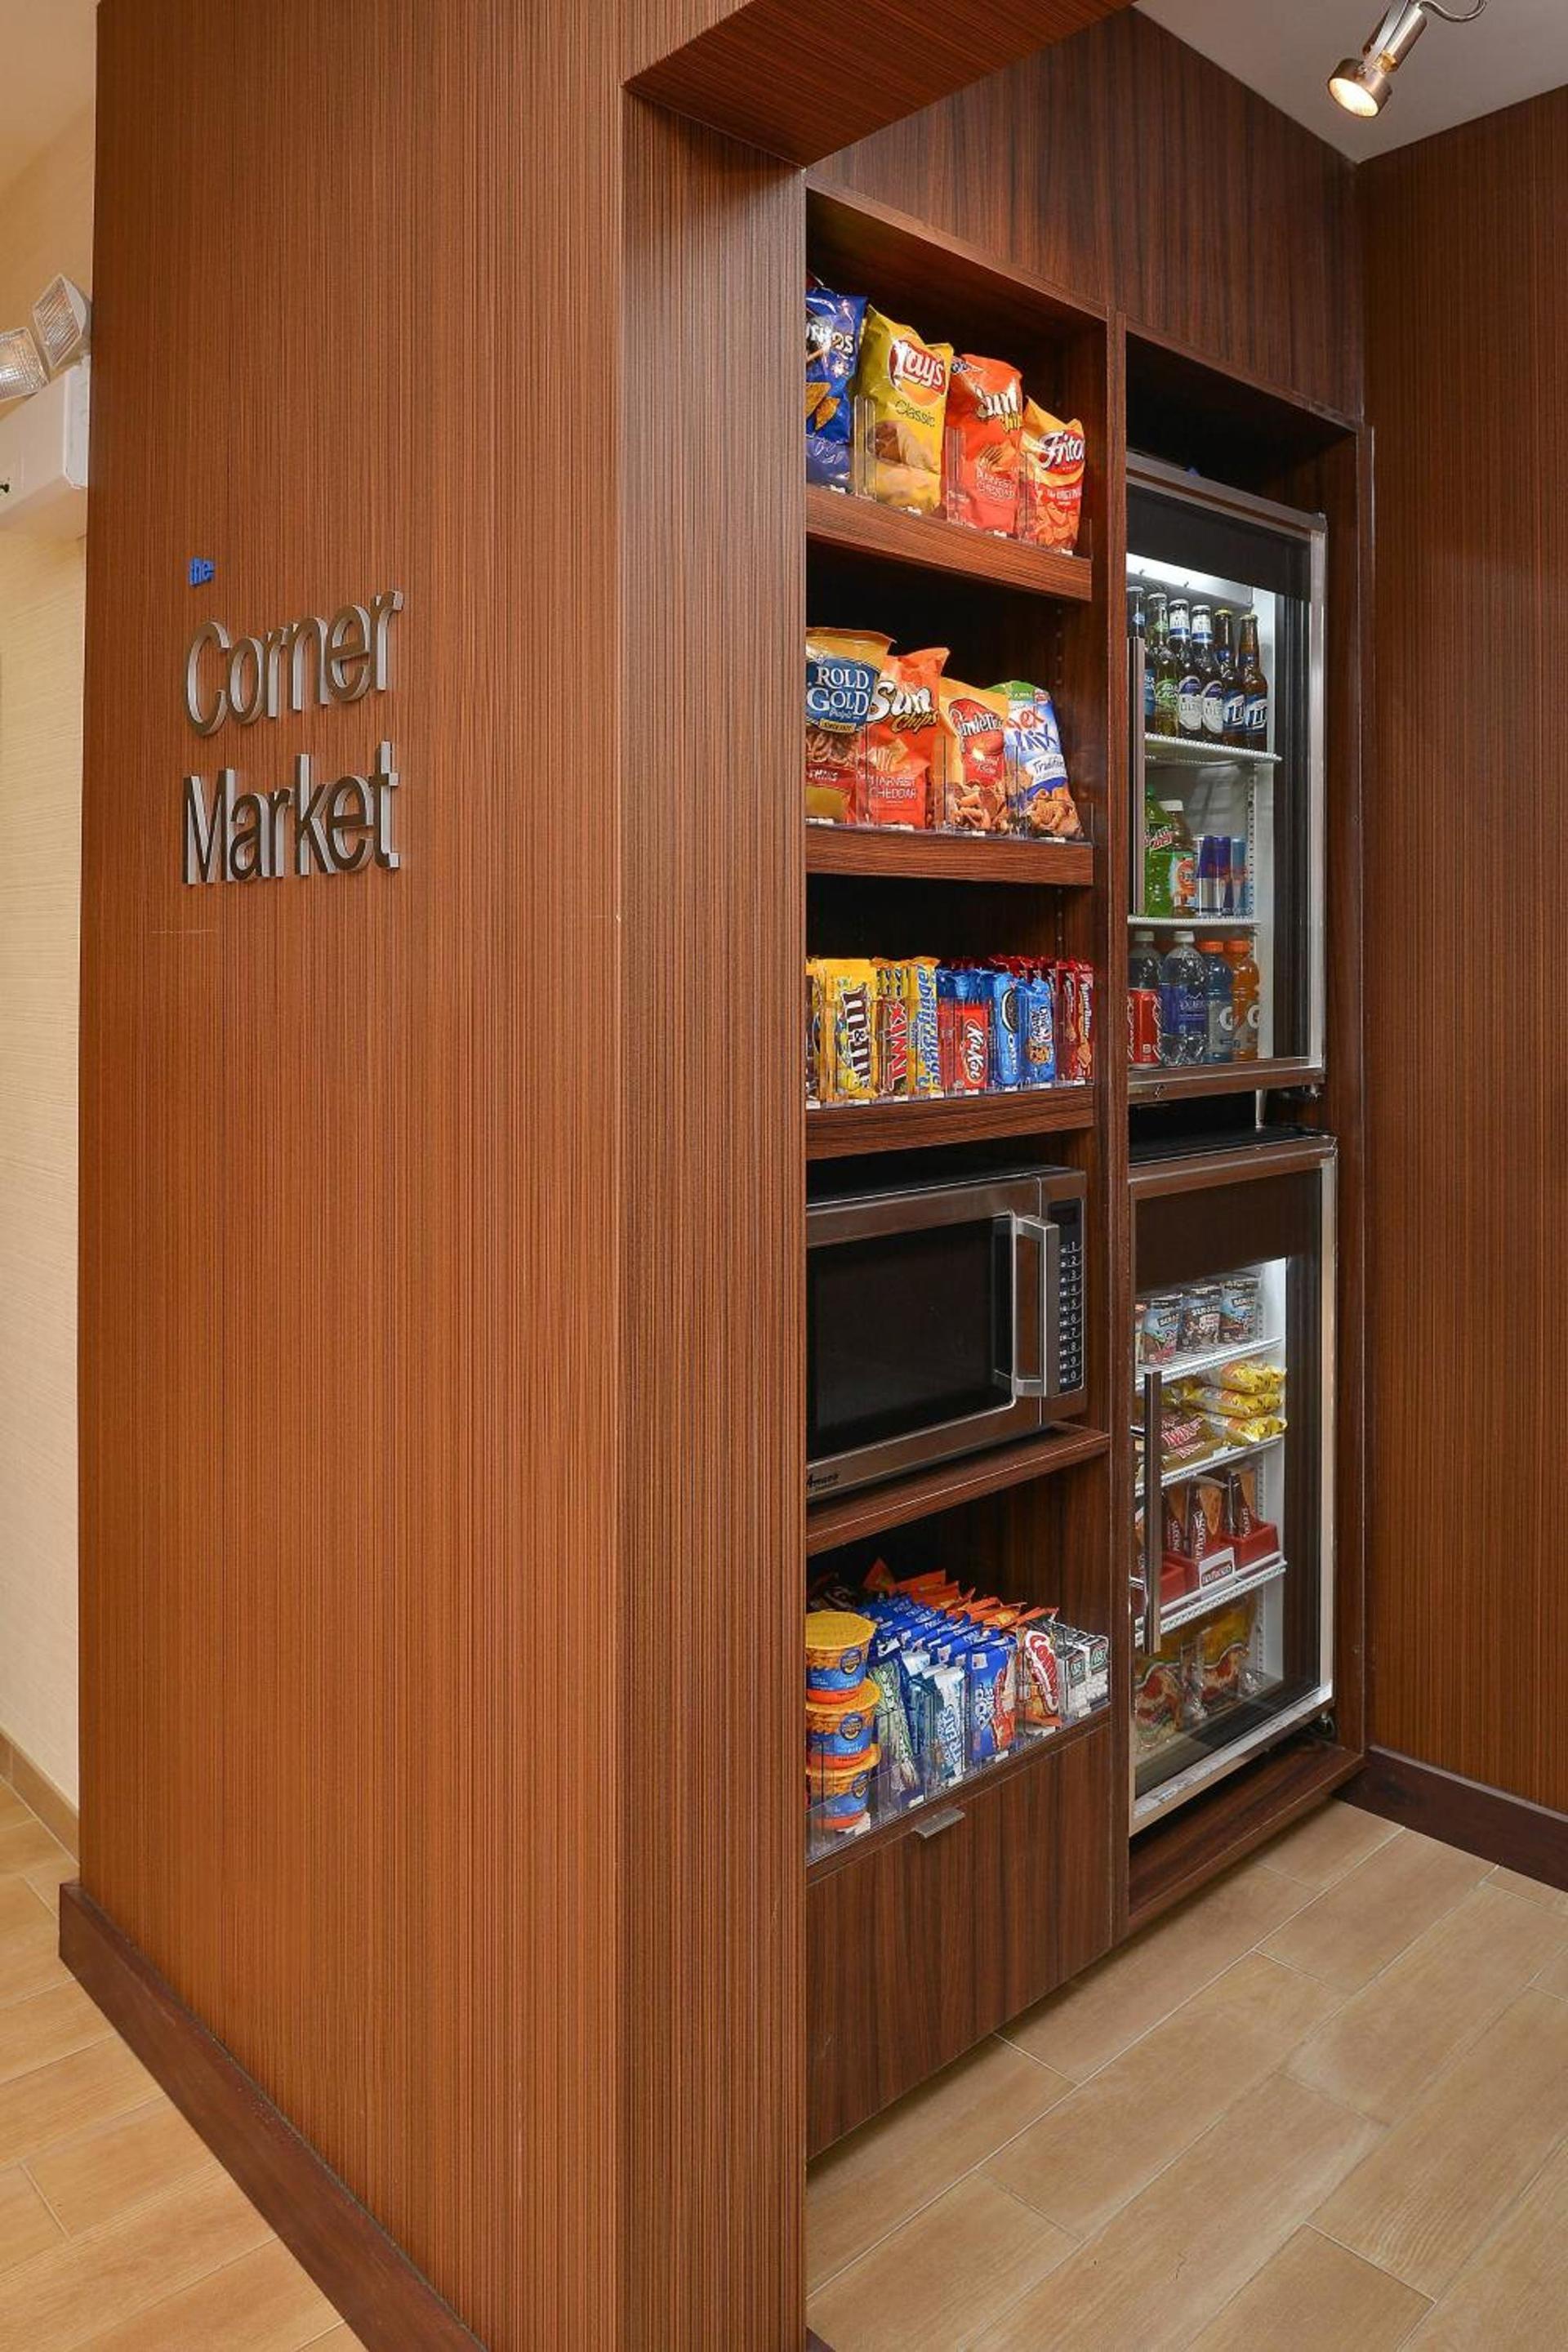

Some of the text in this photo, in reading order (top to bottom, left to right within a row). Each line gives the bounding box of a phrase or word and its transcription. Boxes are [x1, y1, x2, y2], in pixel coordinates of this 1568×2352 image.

[894, 399, 936, 428] Classic
[189, 556, 215, 587] the
[185, 590, 403, 736] Corner
[816, 666, 869, 690] ROLD
[807, 686, 869, 716] GOLD
[866, 680, 933, 724] Sun
[892, 710, 939, 734] Chips
[182, 740, 401, 885] Market
